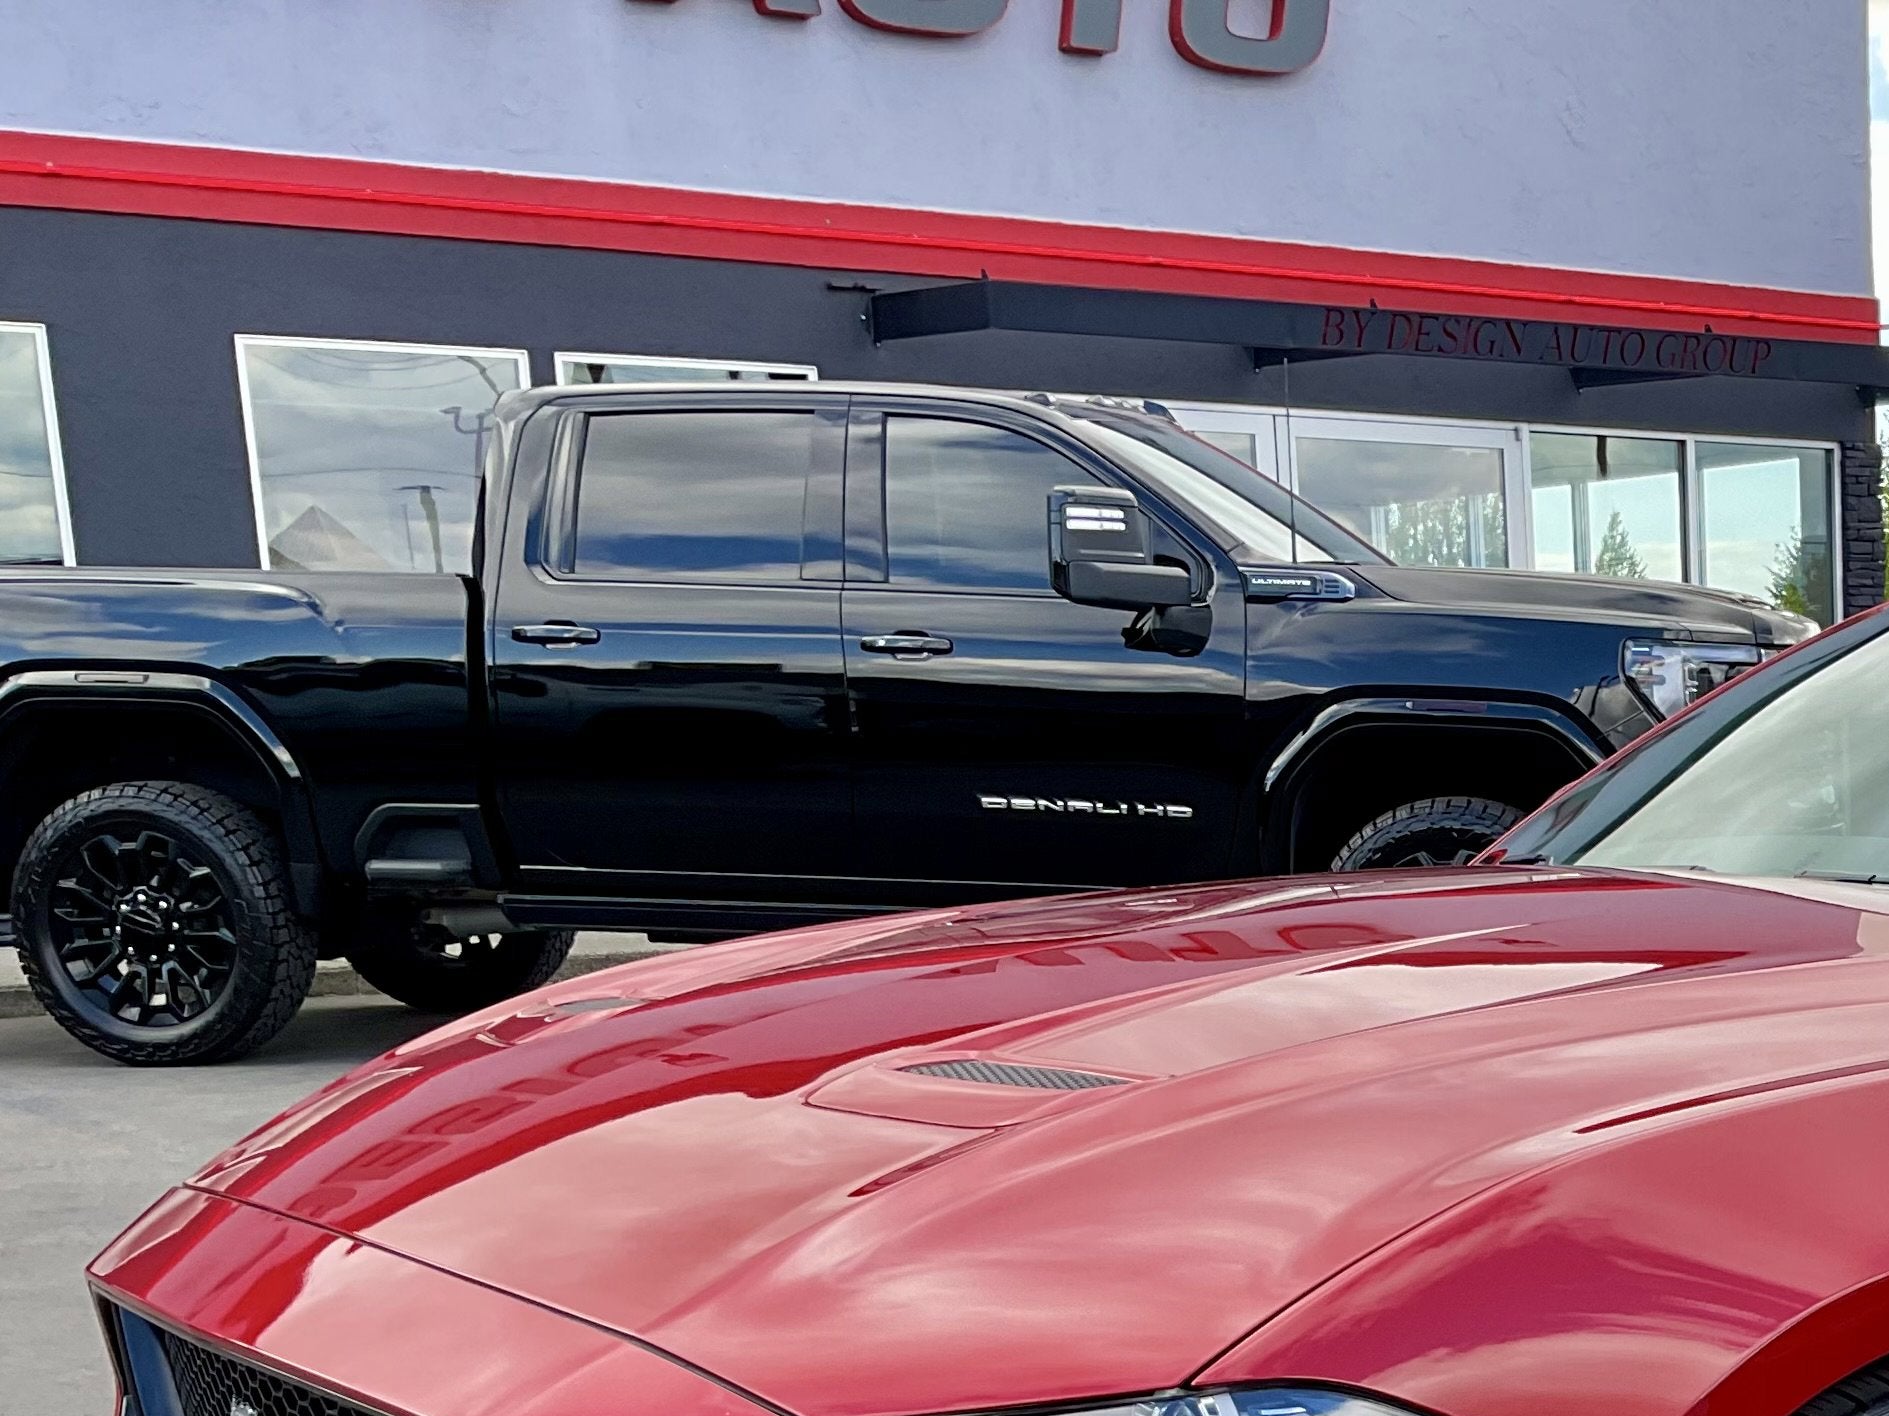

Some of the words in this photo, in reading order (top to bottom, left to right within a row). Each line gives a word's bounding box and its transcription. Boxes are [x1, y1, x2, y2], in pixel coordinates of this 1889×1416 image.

[1321, 308, 1376, 348] BY
[1387, 313, 1528, 358] DESIGN
[1539, 325, 1646, 367] AUTO
[1655, 333, 1772, 375] GROUP
[979, 795, 1128, 815] DENALI
[1138, 802, 1194, 818] HD
